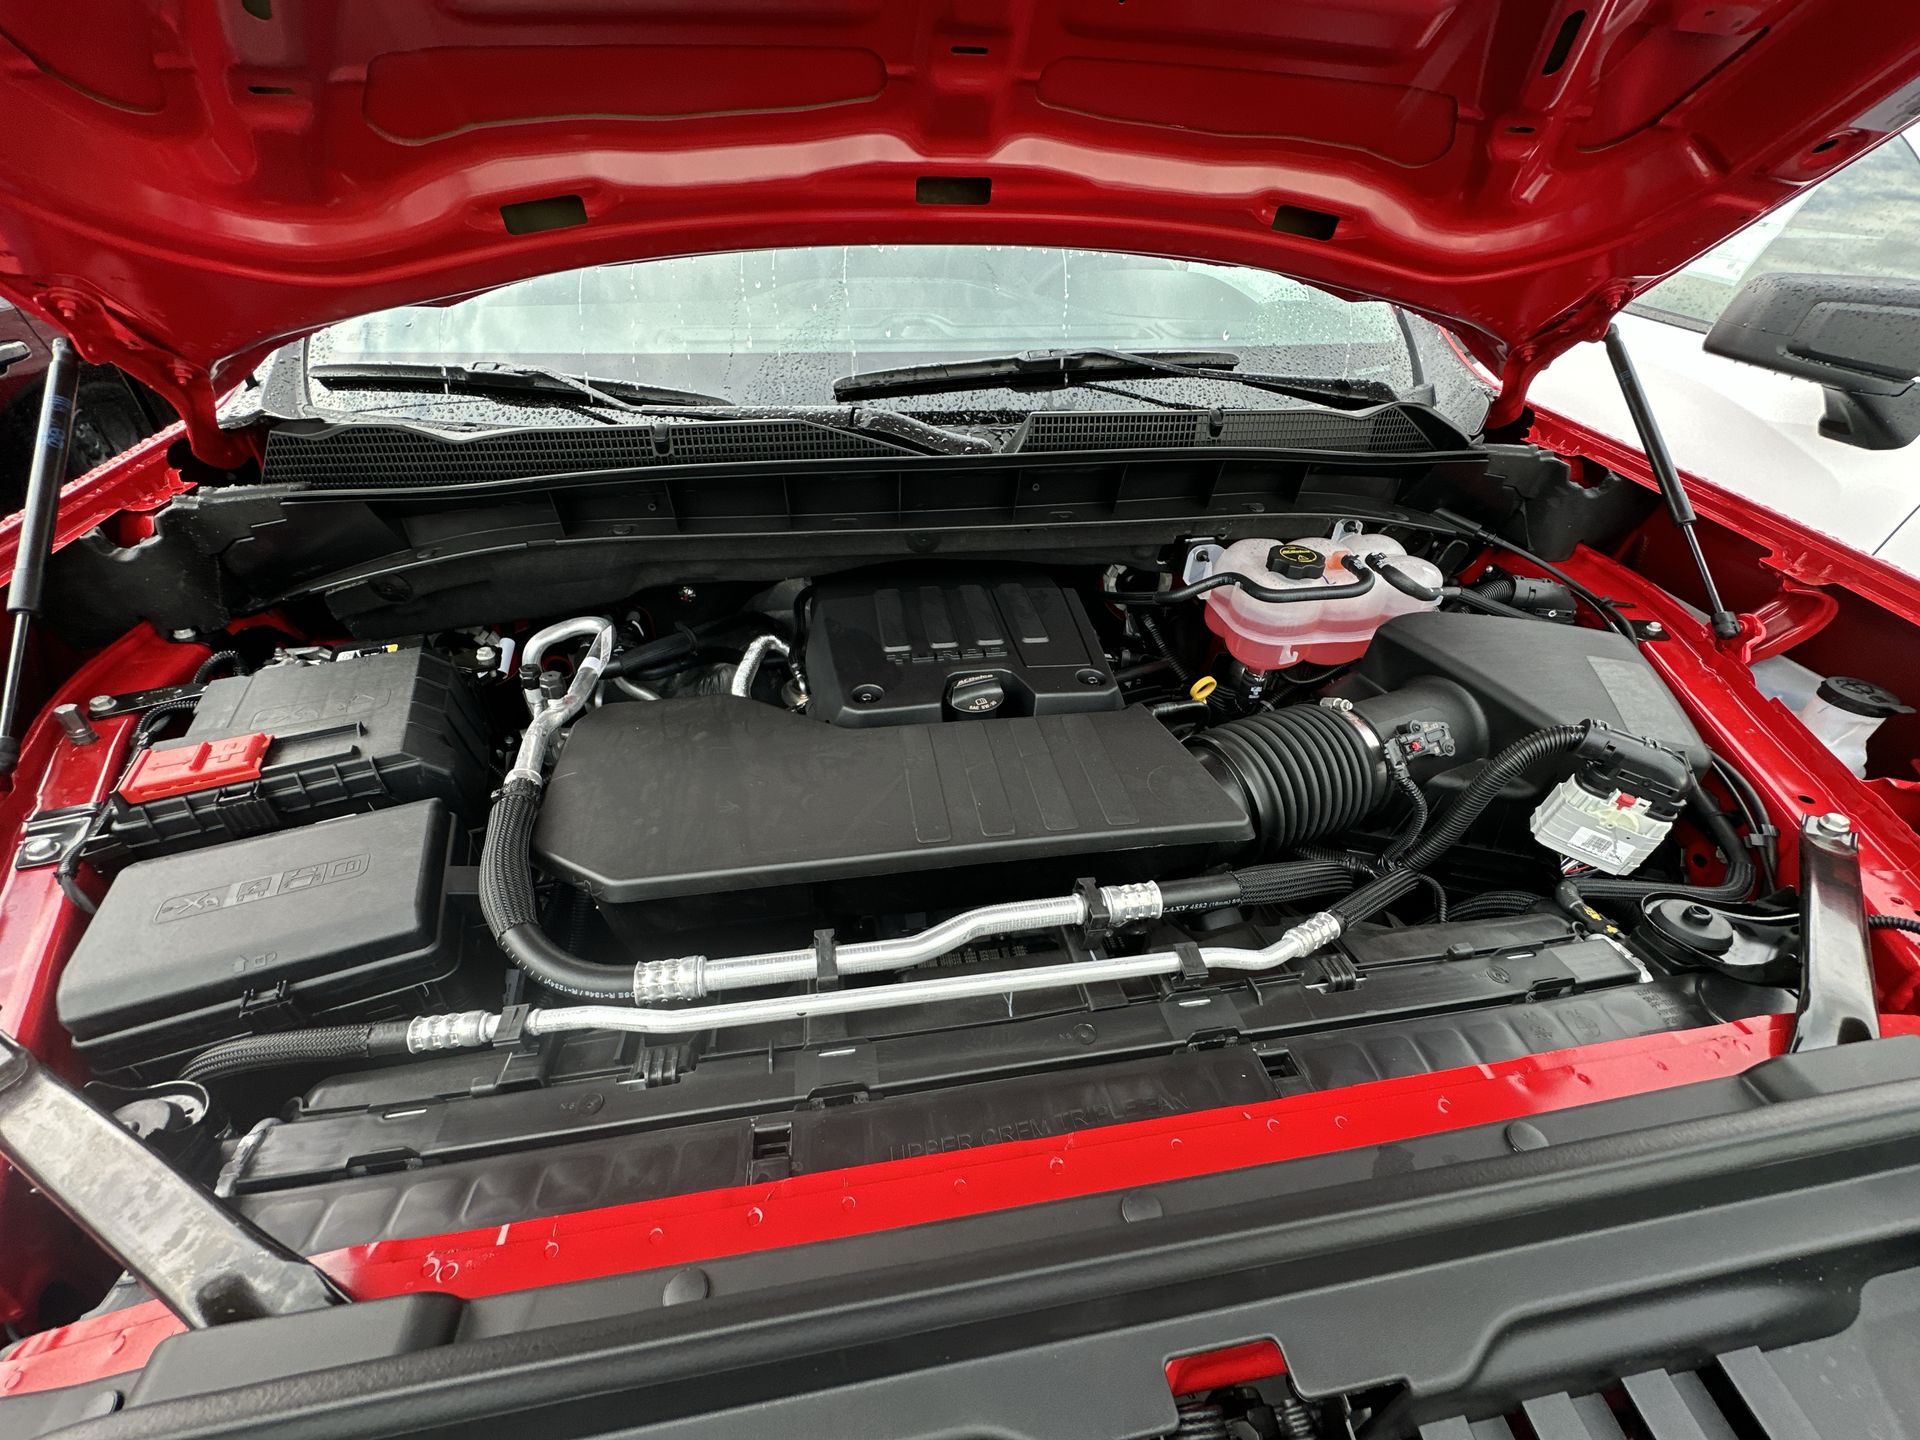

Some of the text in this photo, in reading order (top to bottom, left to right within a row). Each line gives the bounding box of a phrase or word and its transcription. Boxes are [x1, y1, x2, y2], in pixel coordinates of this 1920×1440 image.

[957, 673, 994, 687] ACDelco
[889, 1133, 974, 1162] UPPER
[1054, 1100, 1139, 1131] TRIPLE
